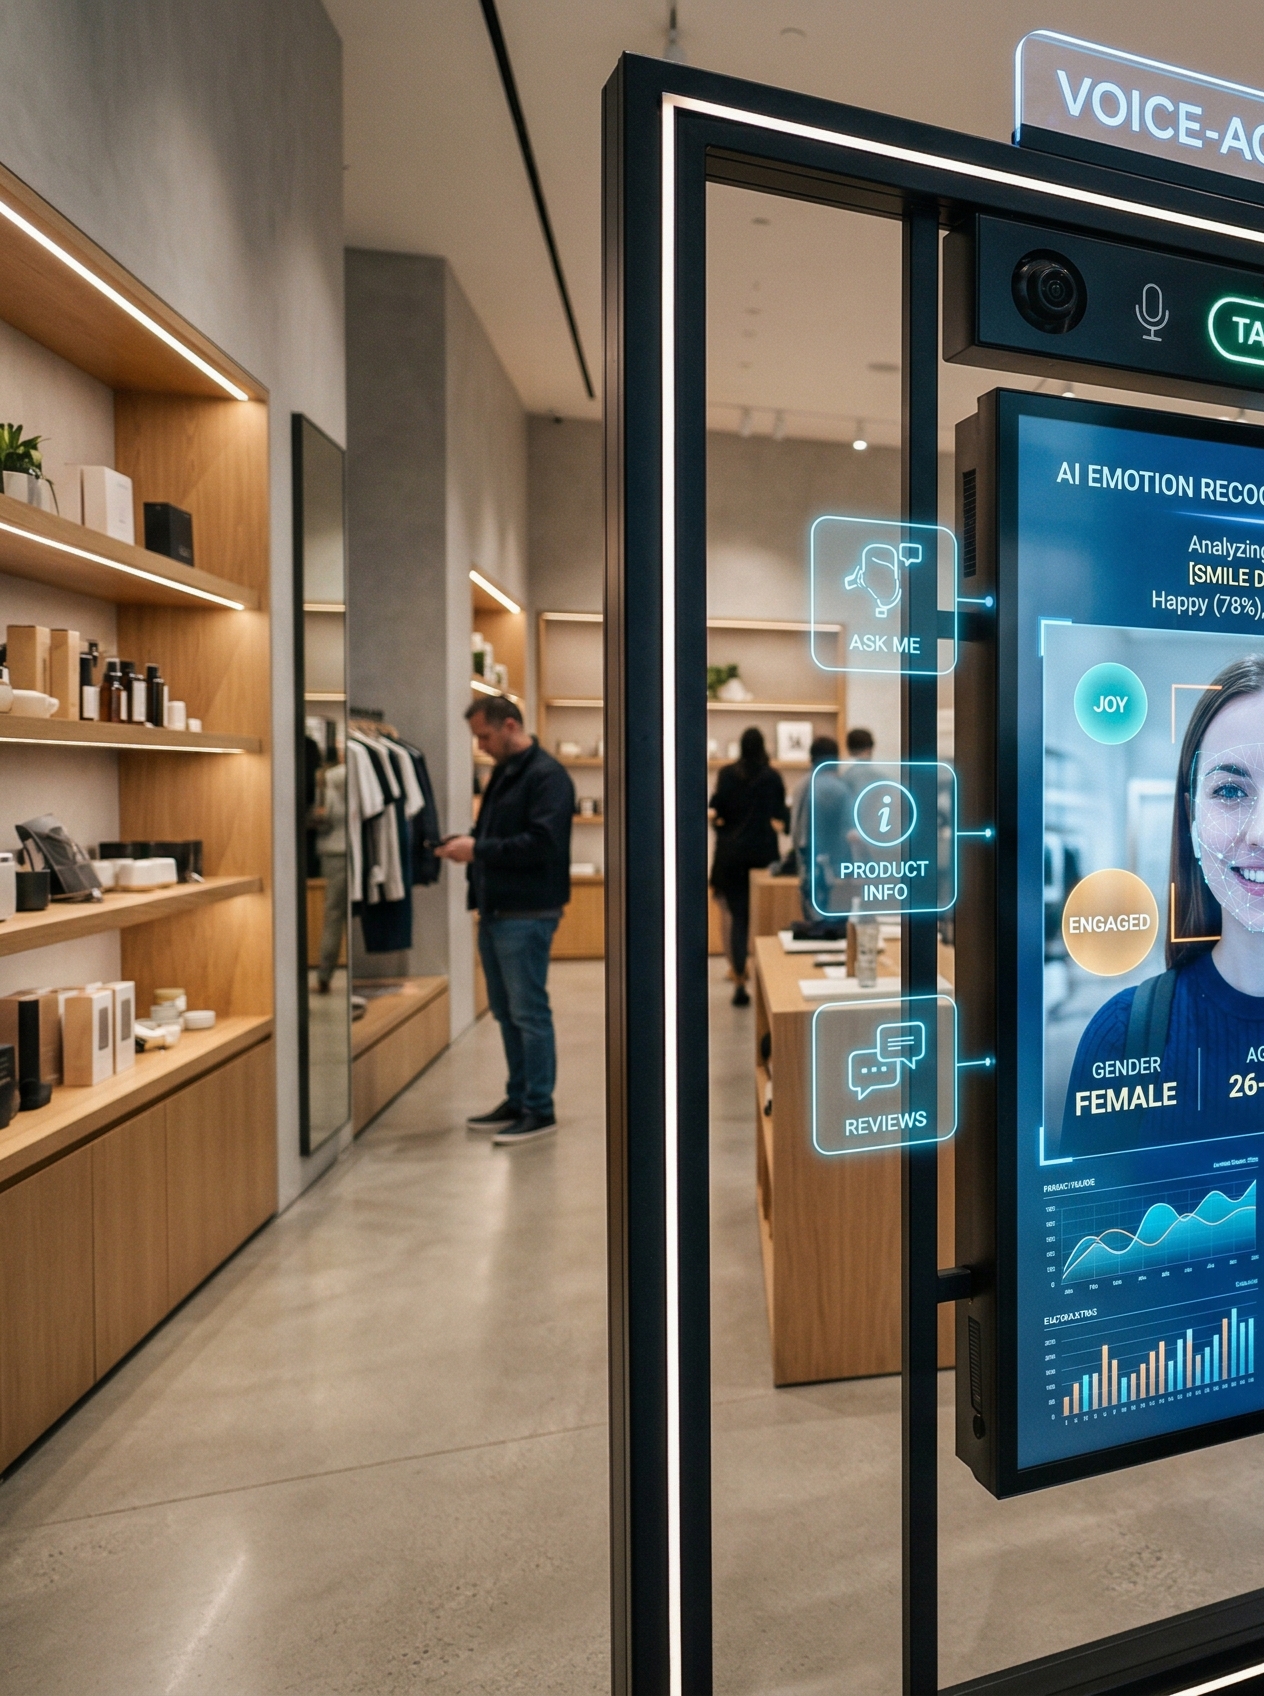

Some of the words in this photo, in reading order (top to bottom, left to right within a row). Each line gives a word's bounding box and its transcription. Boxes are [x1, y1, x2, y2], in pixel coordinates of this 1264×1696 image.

[1056, 461, 1080, 486] AI
[1087, 464, 1194, 498] EMOTION
[1188, 562, 1249, 587] [SMILE
[1152, 590, 1208, 616] Happy
[849, 633, 888, 652] ASK
[892, 636, 921, 654] ME
[1093, 695, 1128, 714] JOY
[840, 860, 929, 879] PRODUCT
[863, 883, 908, 901] INFO
[1069, 913, 1151, 934] ENGAGED
[1092, 1056, 1161, 1080] GENDER
[1075, 1081, 1178, 1117] FEMALE
[845, 1110, 928, 1136] REVIEWS
